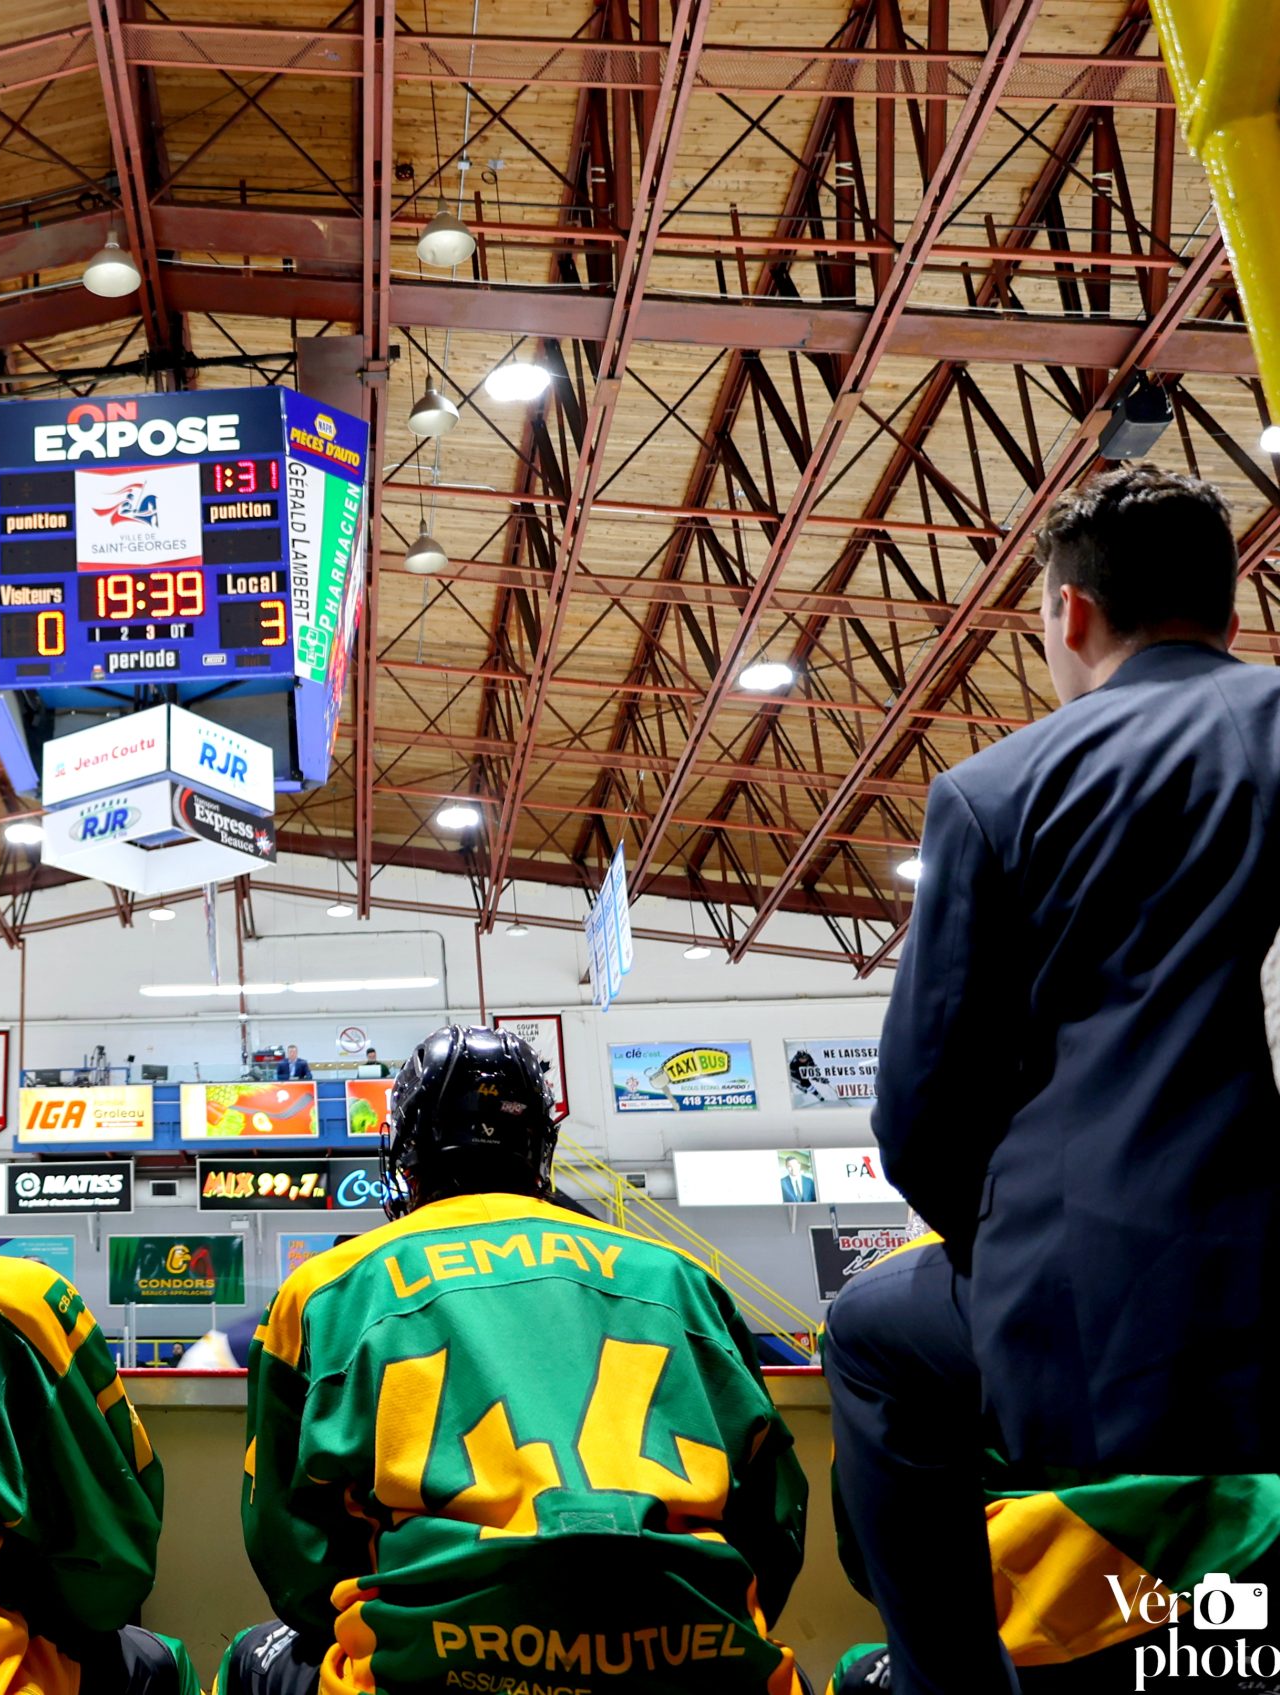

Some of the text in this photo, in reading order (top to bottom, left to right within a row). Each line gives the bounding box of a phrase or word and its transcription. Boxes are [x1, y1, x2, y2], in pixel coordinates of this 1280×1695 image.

[66, 401, 138, 424] ON
[34, 413, 241, 463] EXPOSE
[289, 426, 360, 468] PIÈCES D'AUTO
[213, 460, 280, 494] 1:31
[5, 512, 68, 535] punition
[209, 501, 272, 524] punition
[90, 539, 188, 555] SAINT-GEORGES
[119, 532, 156, 542] VILLE DE
[288, 461, 311, 621] GÉRALD LAMBERT
[318, 481, 362, 633] PHARMACIEN
[96, 570, 204, 619] 19:39
[226, 571, 278, 595] Local
[0, 585, 63, 606] Visiteurs
[37, 610, 65, 657] 0
[120, 626, 130, 641] 2
[145, 624, 156, 640] 3
[169, 622, 187, 639] OT
[260, 599, 287, 647] 3
[73, 751, 110, 773] Jean
[110, 737, 156, 760] Coutu
[198, 741, 248, 783] RJR
[81, 807, 129, 841] RJR
[193, 802, 255, 839] Express
[220, 830, 255, 853] Beauce
[625, 1047, 642, 1059] clé
[823, 1049, 836, 1058] NE
[667, 1054, 726, 1078] TAXI BUS
[800, 1067, 821, 1078] VOS
[824, 1066, 857, 1076] RÊVES
[682, 1096, 701, 1106] 418
[703, 1094, 753, 1105] 221-0066
[25, 1100, 87, 1130] IGA
[93, 1108, 145, 1119] Groleau
[42, 1173, 124, 1195] MATISS
[202, 1171, 255, 1199] MIX
[257, 1172, 320, 1201] 99,7
[839, 1236, 910, 1249] BOUCHE
[383, 1231, 623, 1299] LEMAY
[138, 1278, 216, 1289] CONDORS
[373, 1336, 732, 1541] 44
[431, 1620, 747, 1676] PROMUTUEL
